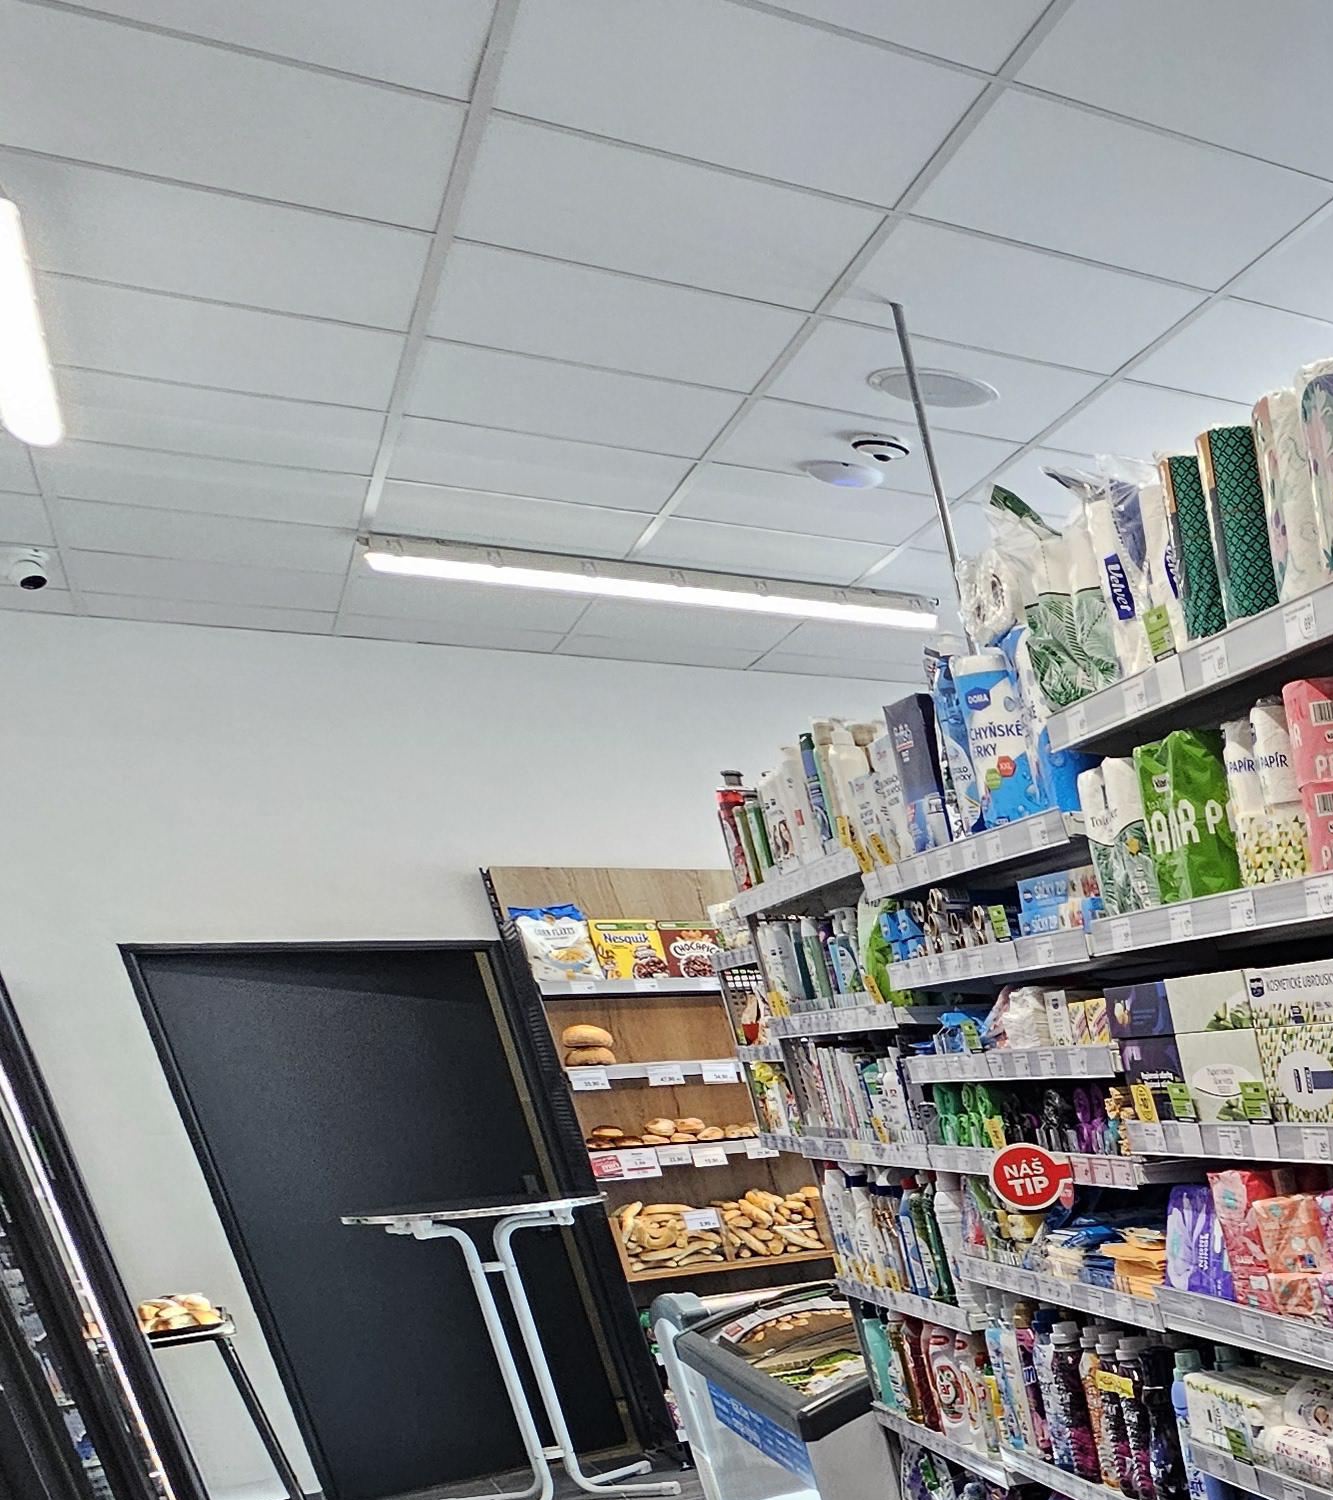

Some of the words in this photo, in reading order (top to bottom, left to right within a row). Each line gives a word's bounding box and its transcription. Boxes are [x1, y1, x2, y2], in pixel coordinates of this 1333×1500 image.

[1107, 562, 1132, 612] Velvet
[1229, 756, 1256, 773] PAPÍR
[1260, 753, 1289, 769] PAPÍR
[603, 932, 650, 947] Nesquik
[1003, 1157, 1046, 1180] NÁŠ
[1007, 1178, 1050, 1197] TIP
